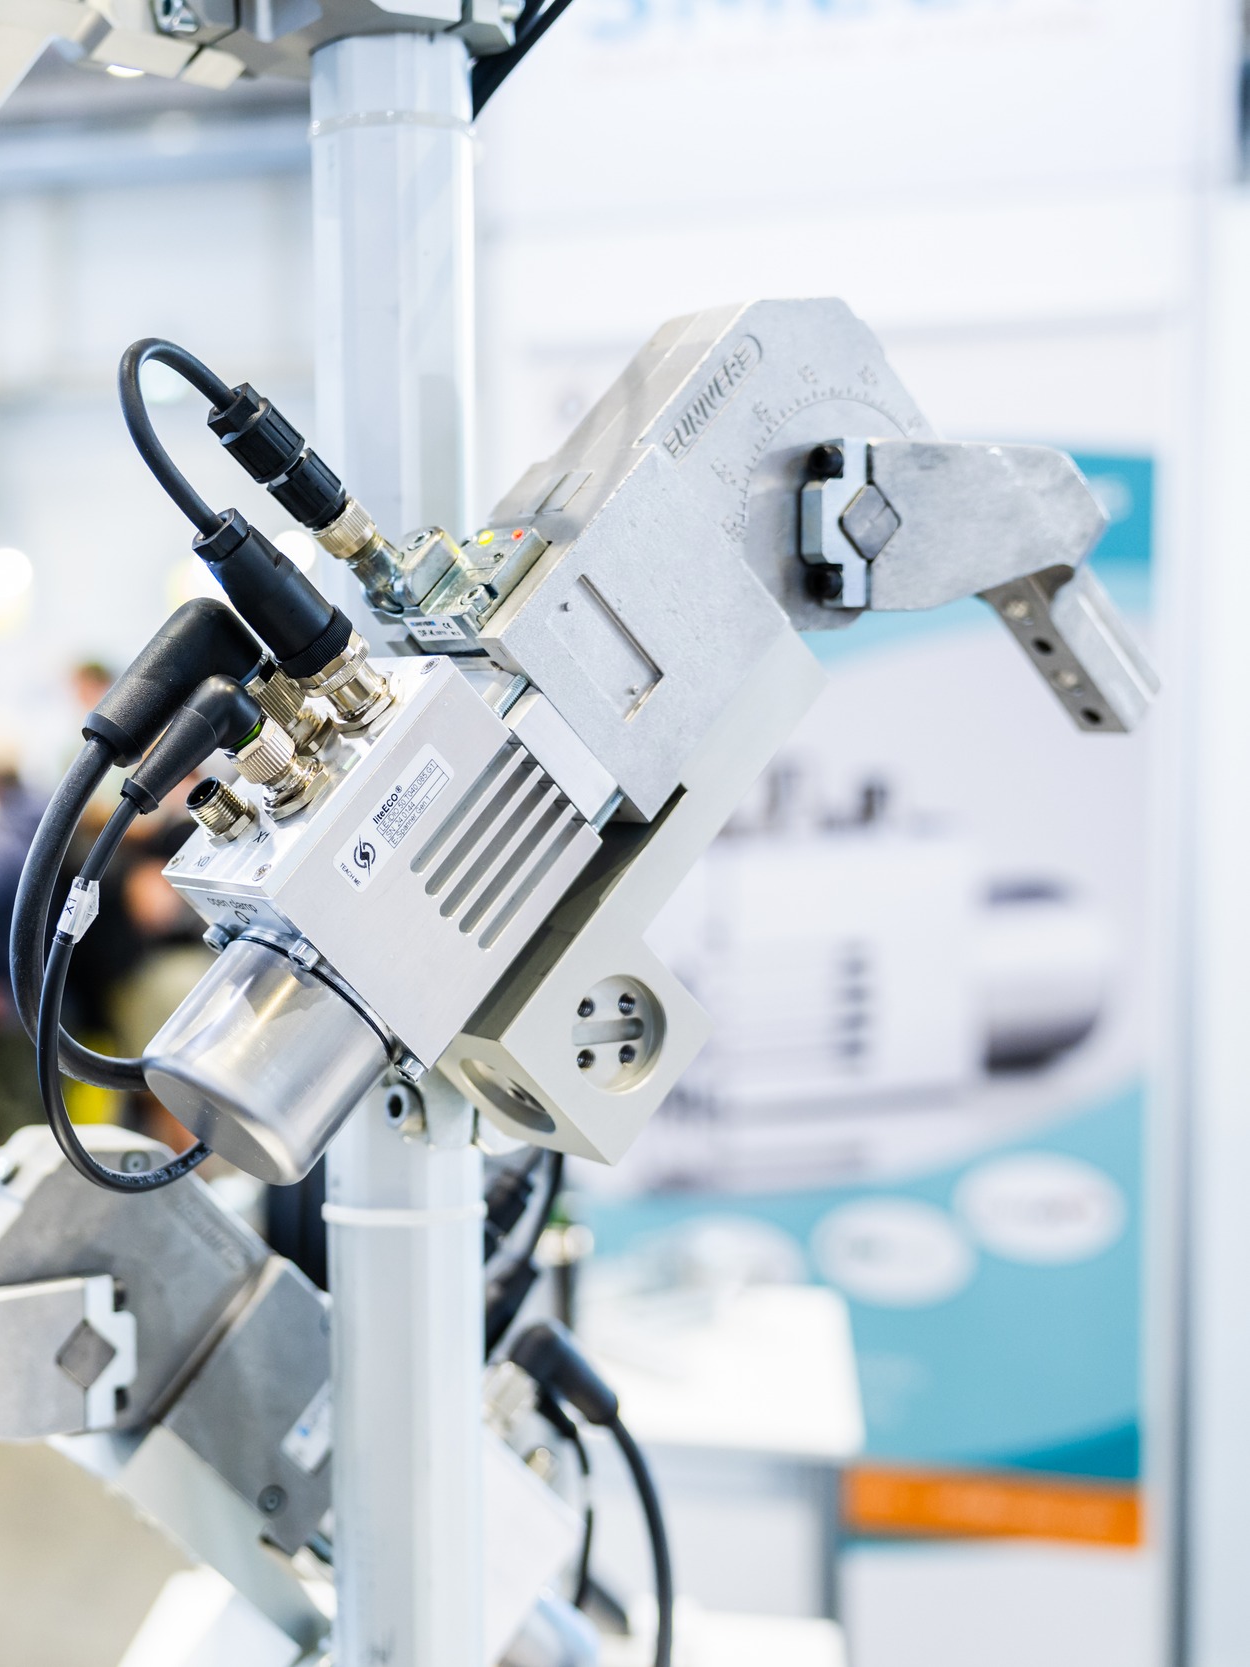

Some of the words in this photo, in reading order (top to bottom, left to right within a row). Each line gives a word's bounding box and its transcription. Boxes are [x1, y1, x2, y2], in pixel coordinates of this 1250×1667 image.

[252, 831, 270, 843] X1
[340, 862, 356, 880] TEACH
[353, 878, 362, 887] ME
[65, 897, 77, 915] X1
